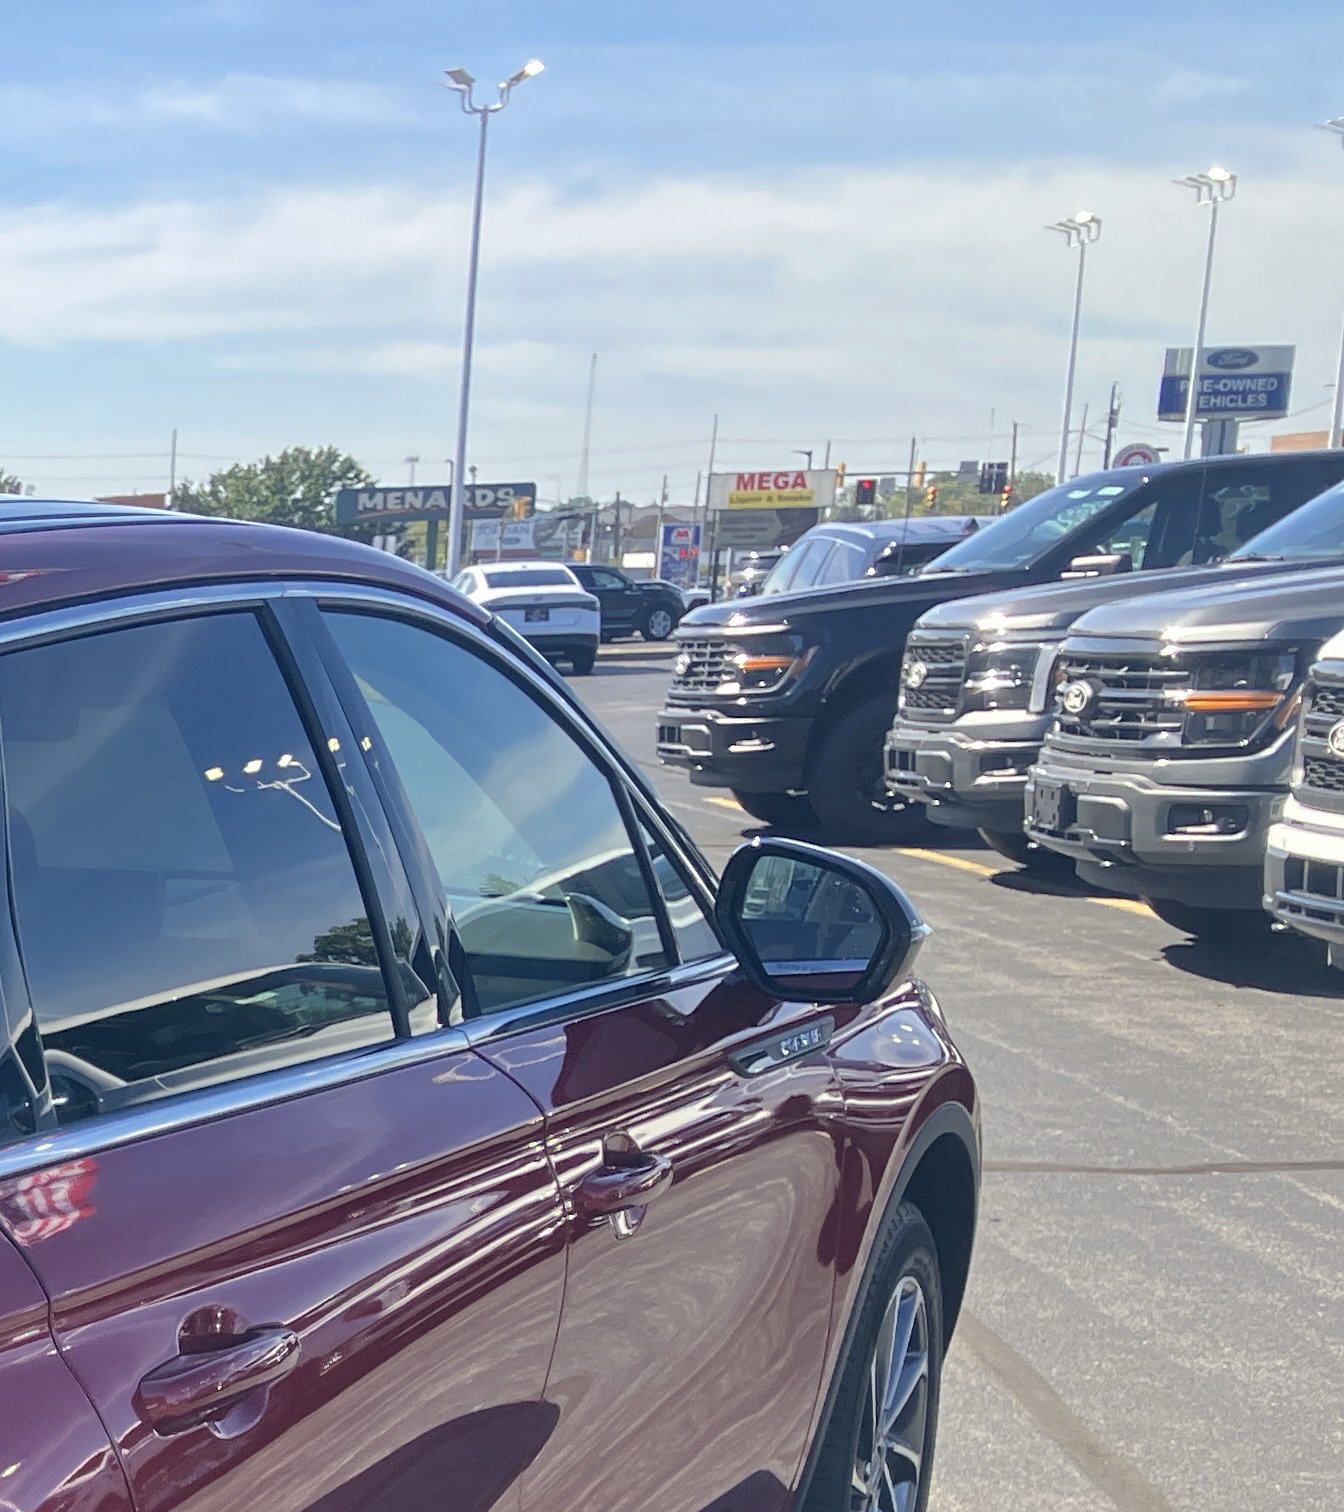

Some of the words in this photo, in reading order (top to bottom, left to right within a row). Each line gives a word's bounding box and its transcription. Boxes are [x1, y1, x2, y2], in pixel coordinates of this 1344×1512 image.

[1179, 377, 1278, 394] PE-OWNED
[1198, 393, 1268, 409] EHICLES
[736, 470, 807, 492] MEGA
